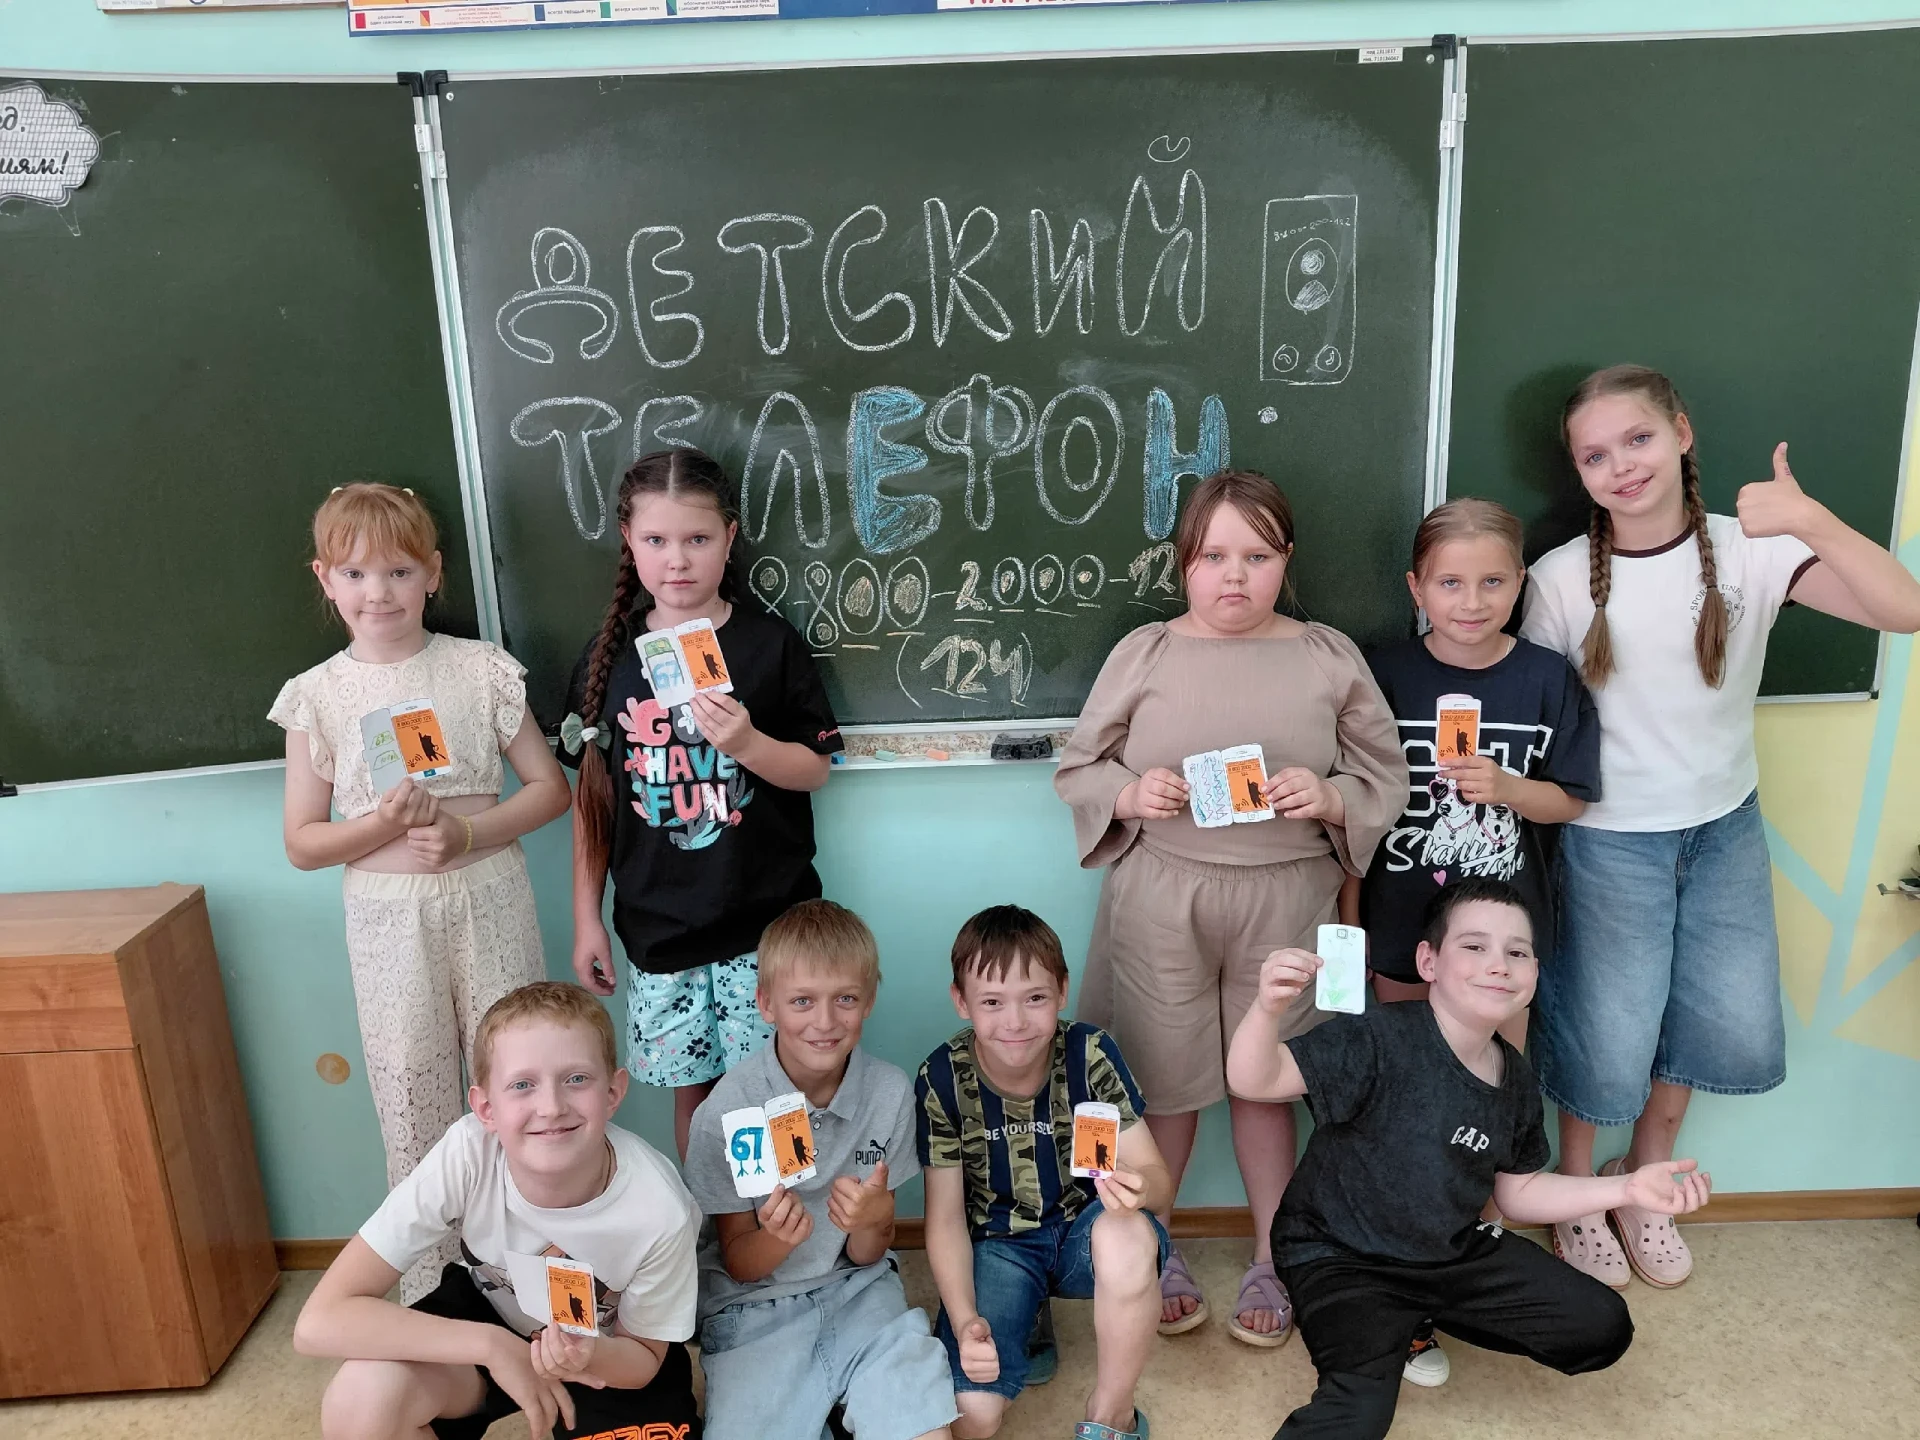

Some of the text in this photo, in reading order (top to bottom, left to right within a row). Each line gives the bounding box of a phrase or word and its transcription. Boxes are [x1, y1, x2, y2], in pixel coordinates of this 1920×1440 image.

[495, 135, 1209, 370] ДЕТСКИЙ
[643, 746, 739, 784] HAVE
[643, 782, 729, 828] FUN
[983, 1128, 1001, 1141] BE
[1450, 1125, 1491, 1153] GAP
